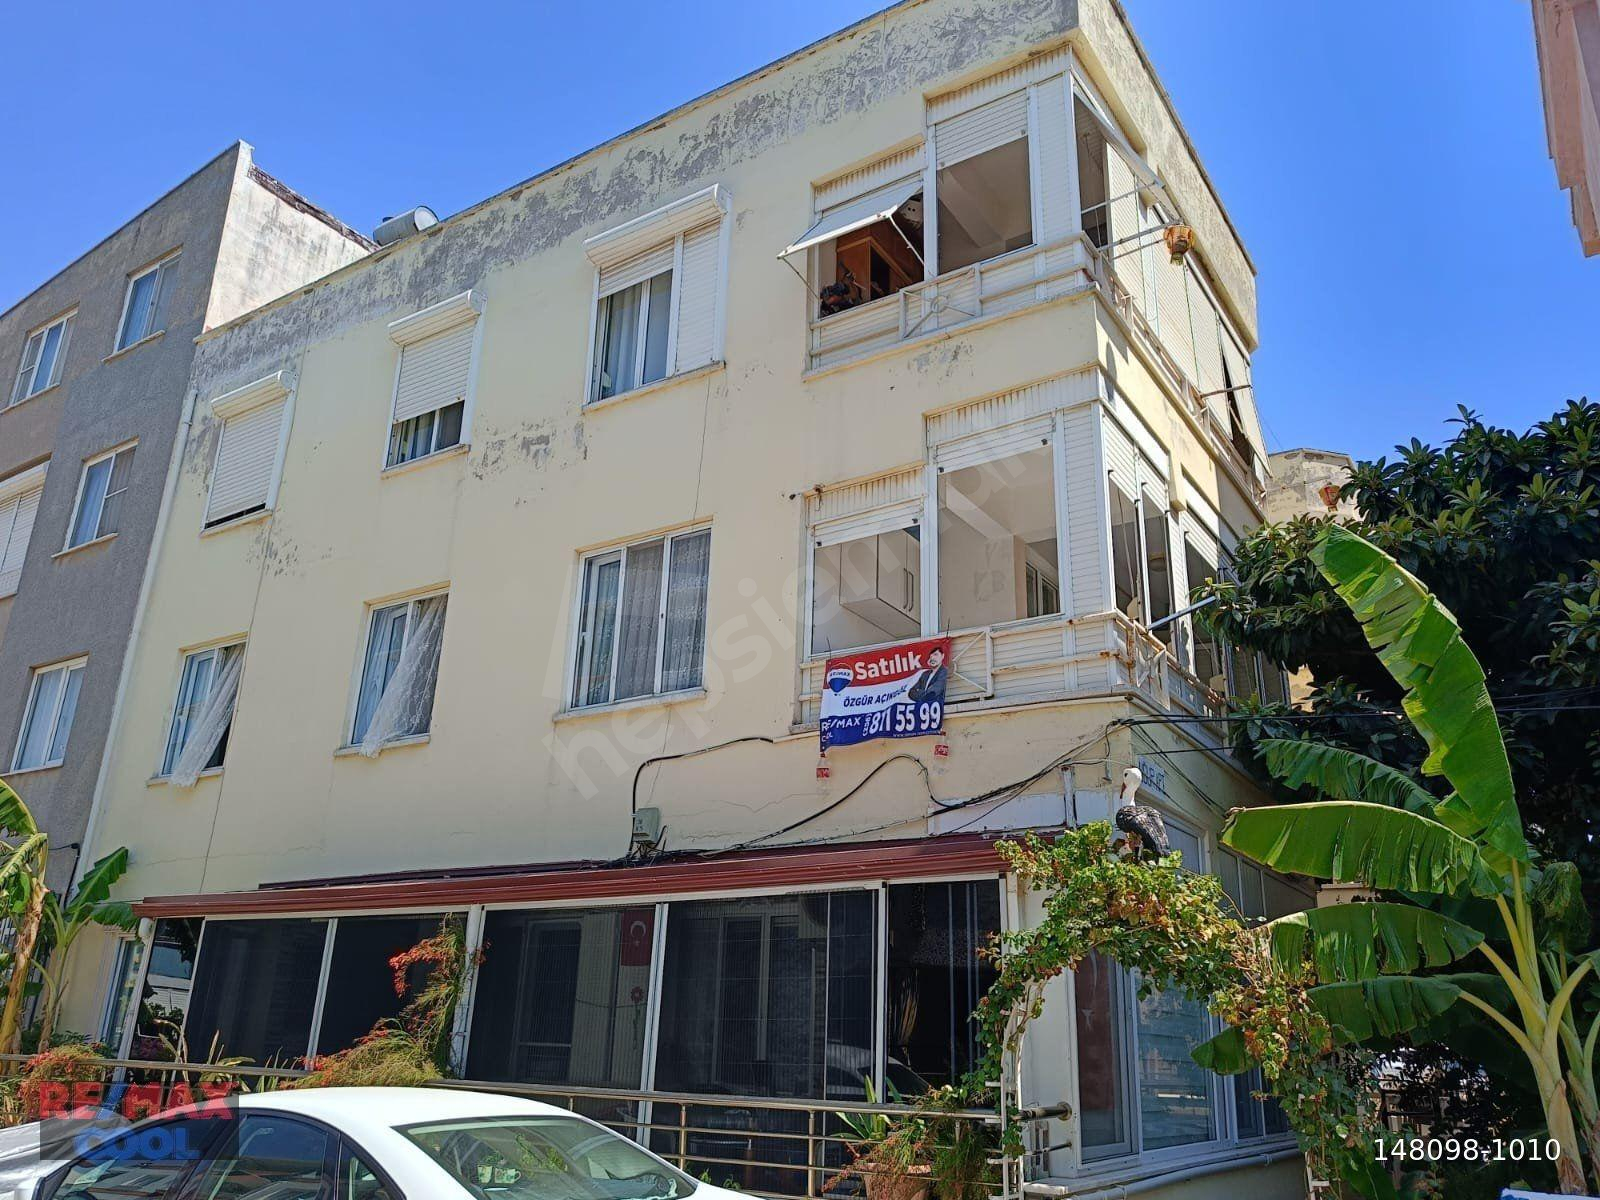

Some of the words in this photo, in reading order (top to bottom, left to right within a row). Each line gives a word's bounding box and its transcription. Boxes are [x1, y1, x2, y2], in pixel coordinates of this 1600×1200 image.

[854, 651, 922, 680] Satılık
[843, 694, 873, 707] ÖZGÜR
[895, 704, 915, 732] 55
[919, 701, 941, 729] 99
